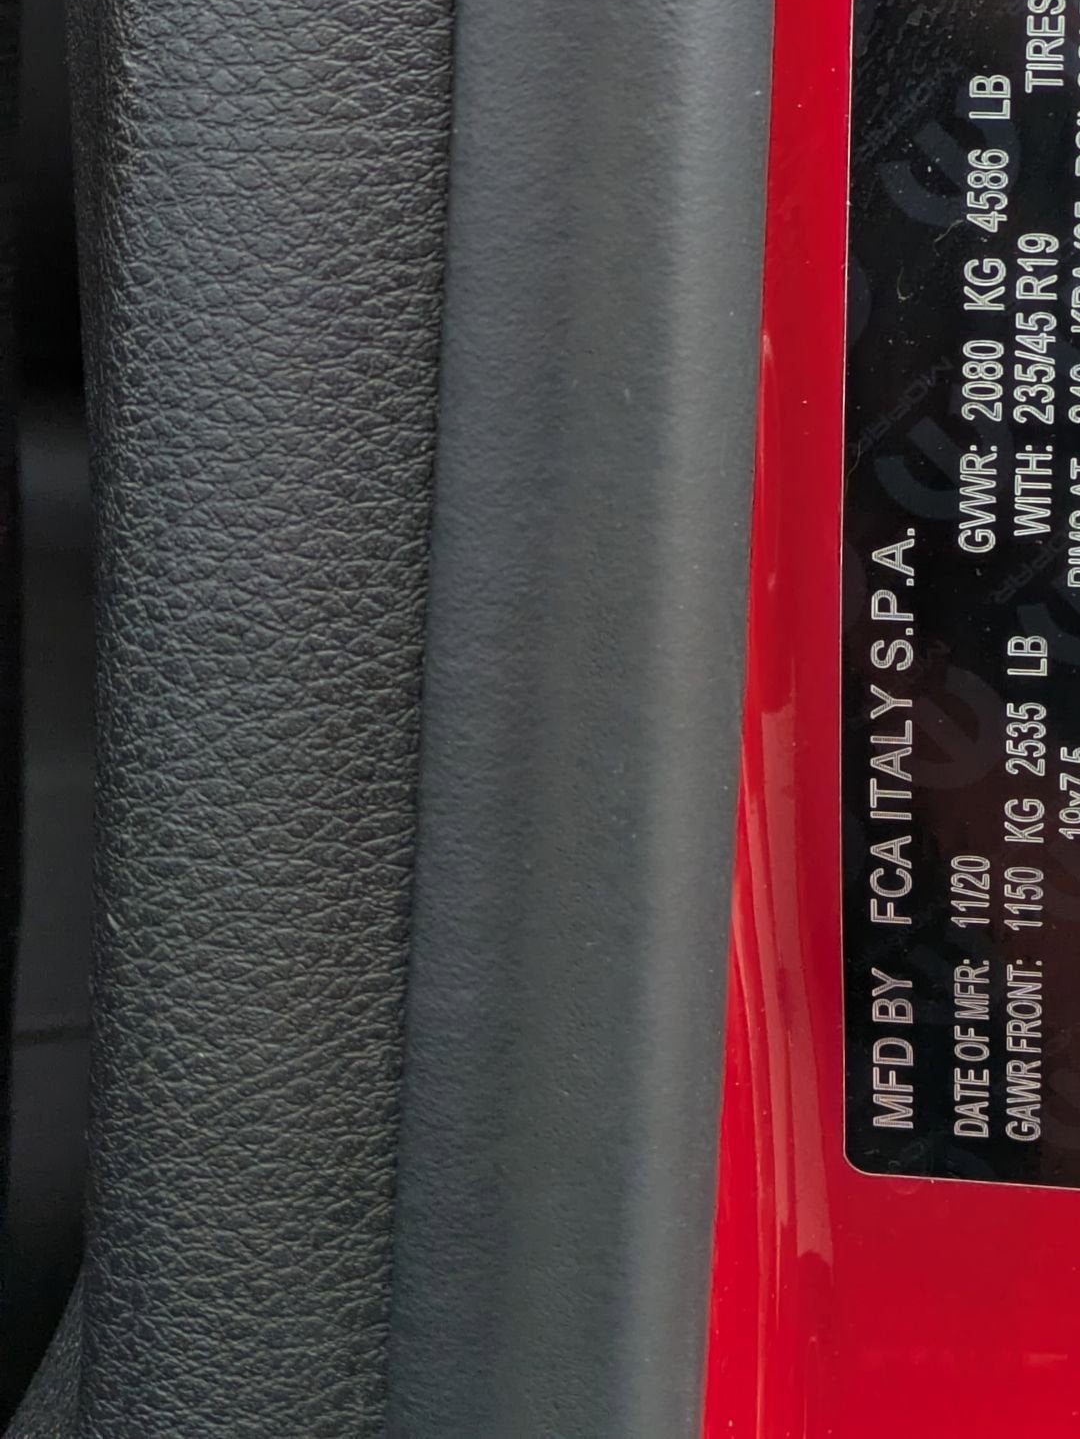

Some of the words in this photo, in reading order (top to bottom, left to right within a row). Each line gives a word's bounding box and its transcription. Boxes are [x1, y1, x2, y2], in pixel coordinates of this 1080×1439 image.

[969, 74, 1012, 119] LB
[966, 148, 1009, 233] 4586
[964, 258, 1006, 311] KG
[1016, 232, 1060, 301] R19
[963, 339, 1005, 422] 2080
[1013, 311, 1057, 424] 235/45
[958, 444, 999, 553] GVWR:
[1013, 445, 1055, 537] WITH:
[871, 527, 916, 672] S.P.A.
[1007, 635, 1049, 677] LB
[870, 683, 914, 821] ITALY
[1006, 701, 1047, 777] 2535
[1005, 797, 1046, 843] KG
[870, 836, 914, 925] FCA
[951, 854, 992, 929] 11/20
[1004, 866, 1045, 932] 1150
[871, 968, 914, 1024] BY
[953, 958, 991, 1021] MFR:
[1007, 959, 1044, 1054] FRONT:
[953, 1024, 990, 1062] OF
[871, 1035, 914, 1129] MFD
[953, 1067, 990, 1139] DATE
[1005, 1059, 1043, 1141] GAWR
